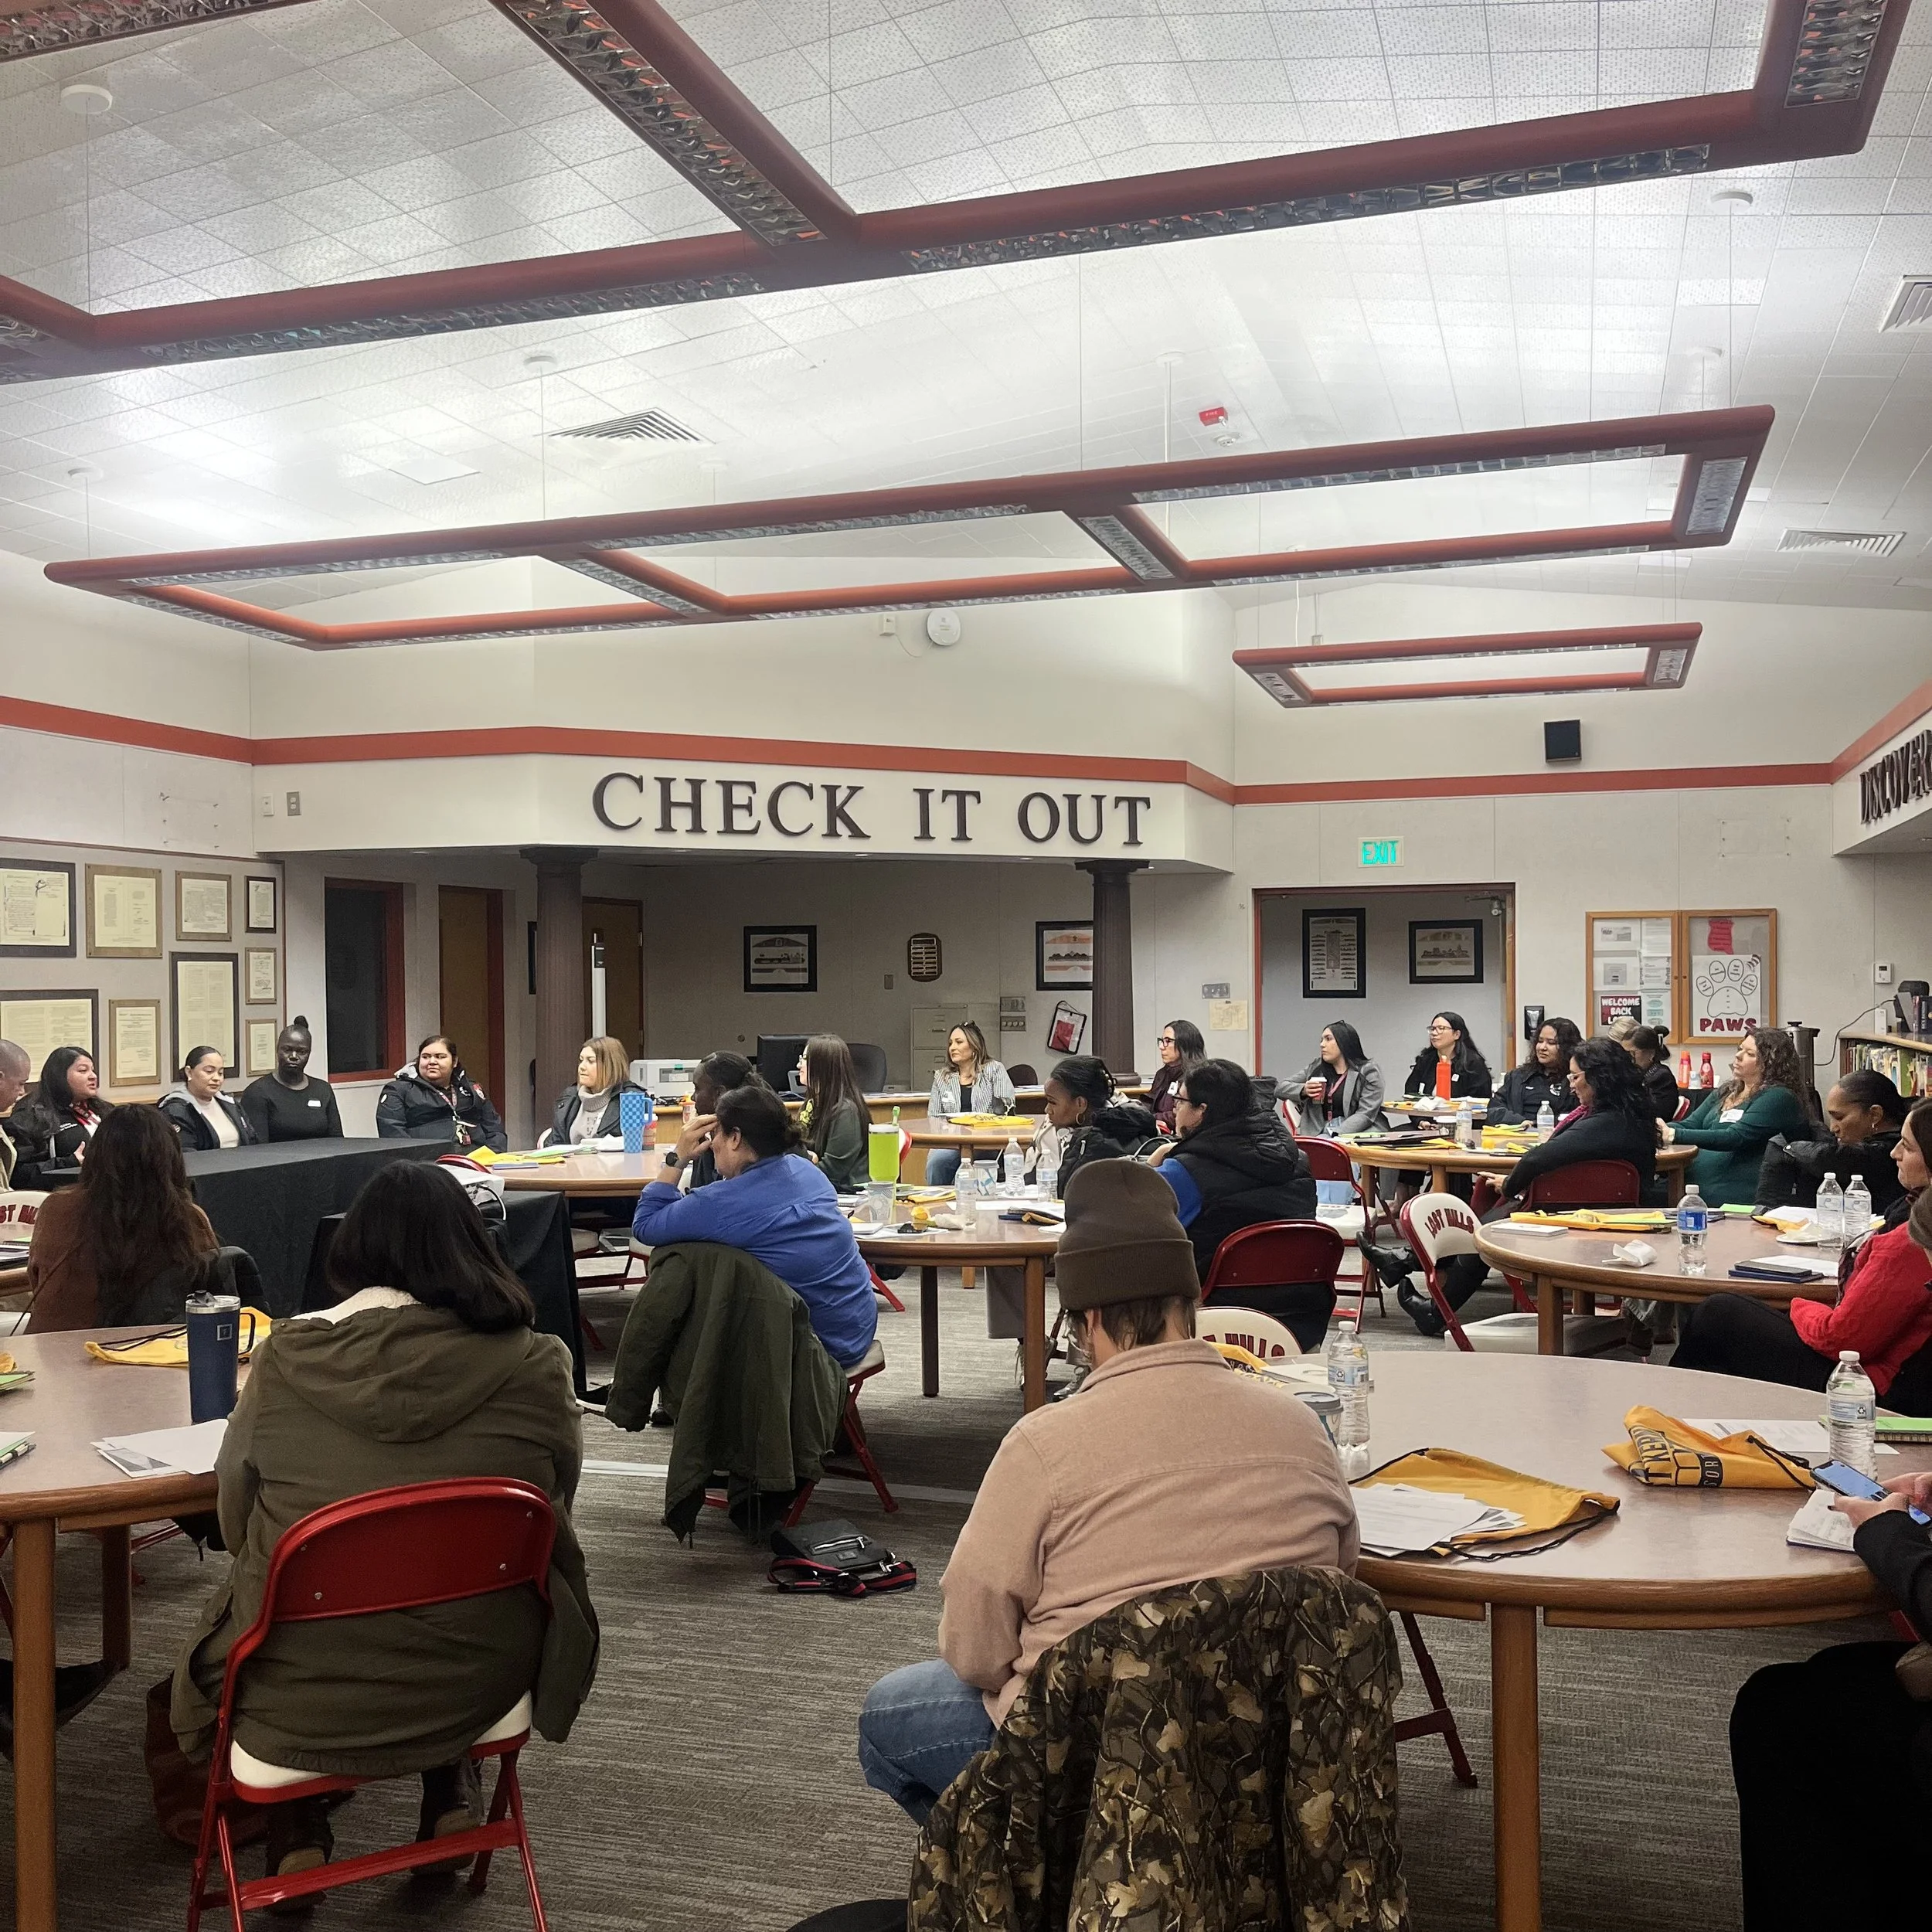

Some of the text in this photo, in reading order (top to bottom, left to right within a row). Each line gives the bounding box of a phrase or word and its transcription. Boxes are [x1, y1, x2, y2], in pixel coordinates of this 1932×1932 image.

[592, 772, 1151, 845] CHECK IT OUT
[1362, 840, 1399, 865] EXIT
[1601, 998, 1640, 1006] WELCOME
[1610, 1007, 1631, 1015] BACK
[1699, 1018, 1757, 1032] PAWS
[1424, 1208, 1475, 1240] LOST HILLS
